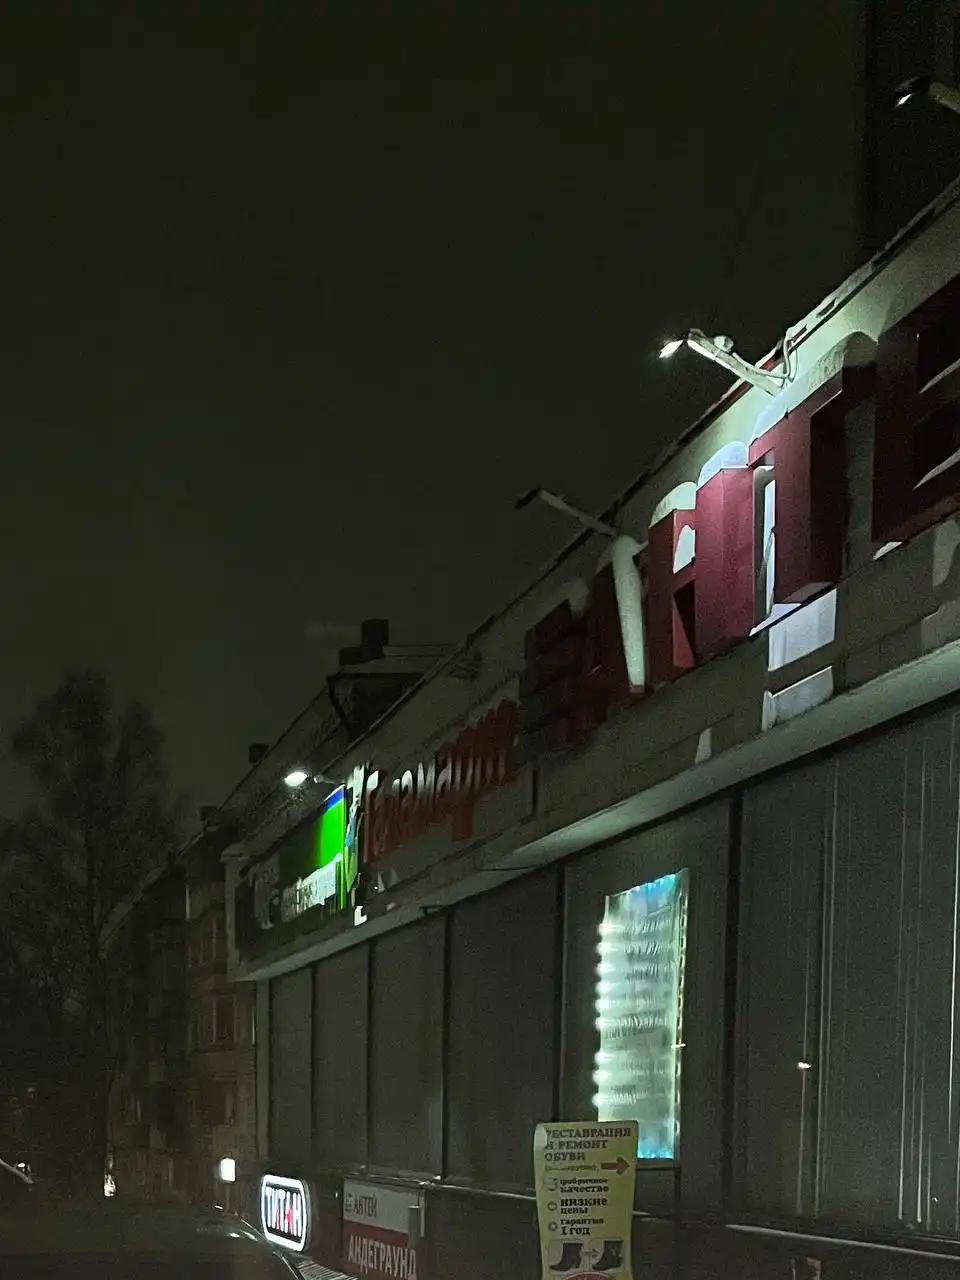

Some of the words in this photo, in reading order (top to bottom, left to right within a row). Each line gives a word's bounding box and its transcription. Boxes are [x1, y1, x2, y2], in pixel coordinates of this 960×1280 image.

[559, 1140, 608, 1149] РЕМОНТ
[545, 1153, 585, 1161] ОБУВИ
[560, 1186, 609, 1194] качество
[560, 1198, 608, 1206] низкие
[265, 1186, 301, 1238] ТИТАН
[560, 1218, 604, 1226] гарантия
[569, 1227, 590, 1236] год
